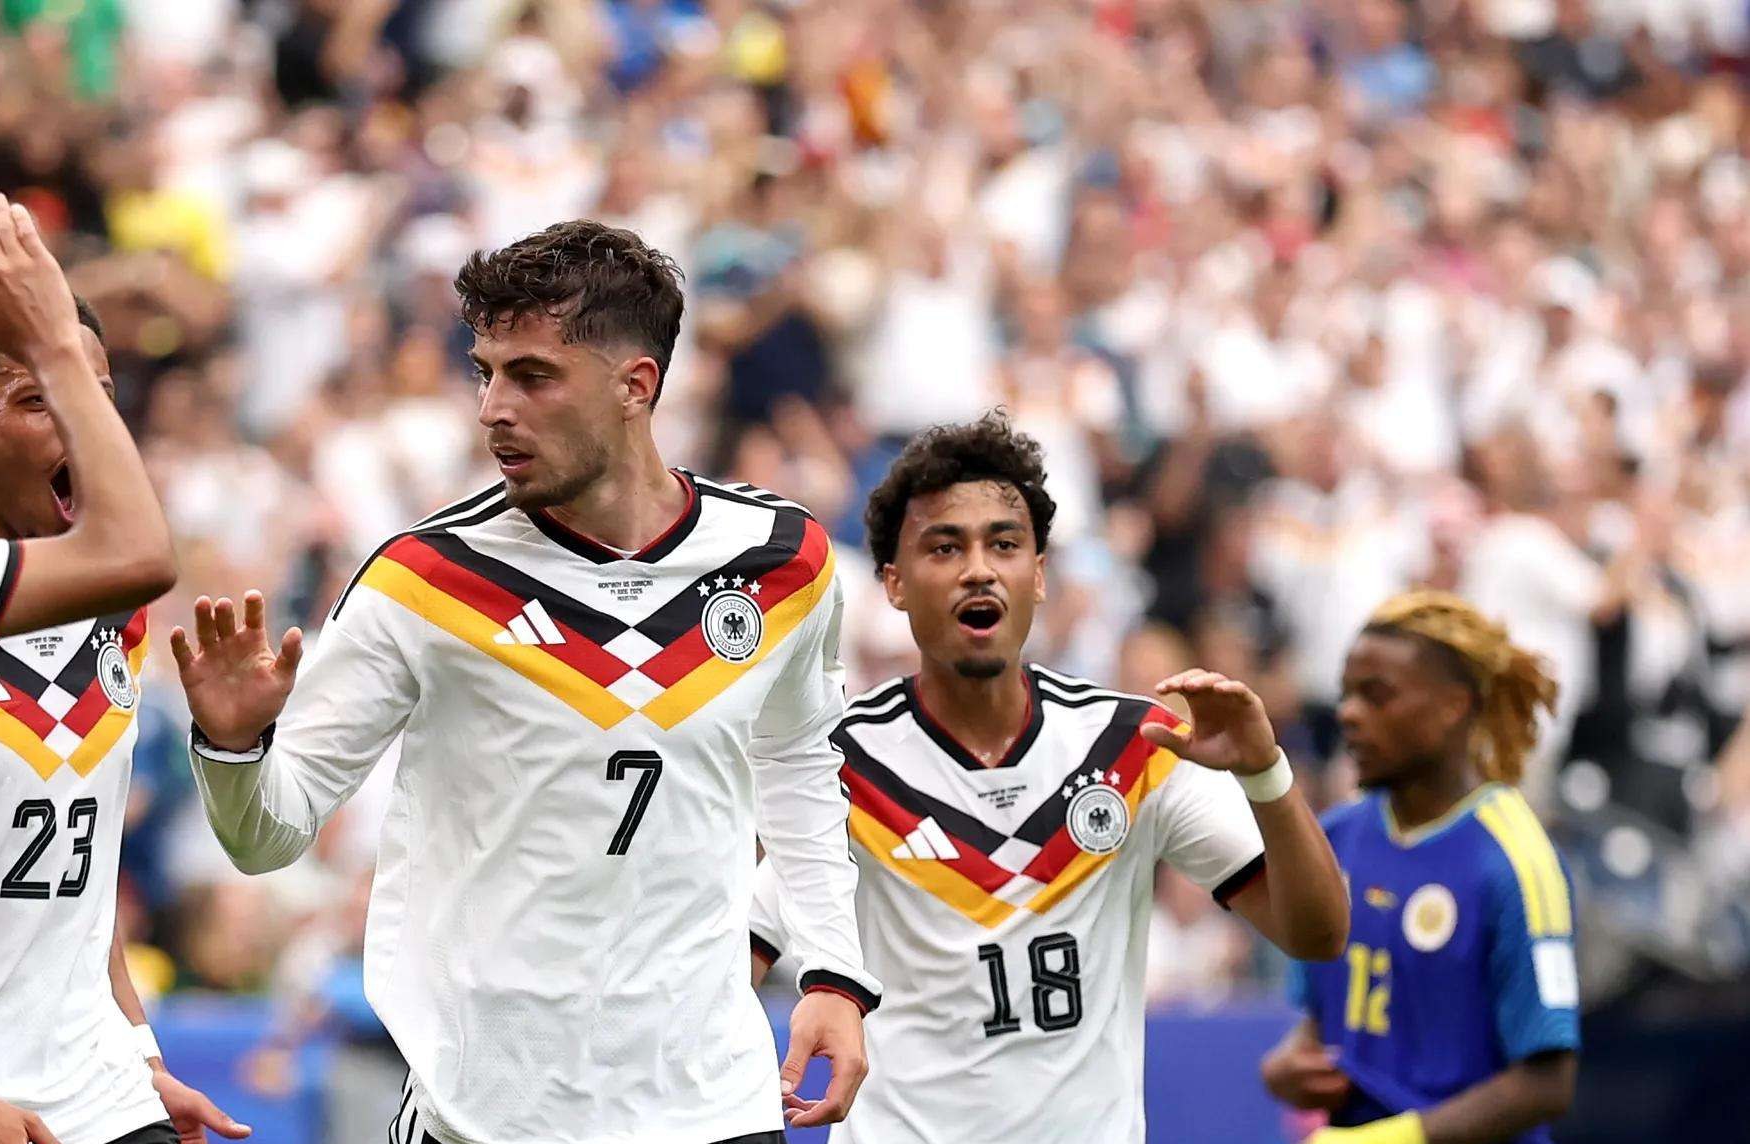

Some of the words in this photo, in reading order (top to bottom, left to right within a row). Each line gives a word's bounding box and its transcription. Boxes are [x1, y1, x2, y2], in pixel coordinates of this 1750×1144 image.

[0, 797, 98, 899] 23
[606, 750, 663, 855] 7
[978, 931, 1083, 1038] 18
[1346, 942, 1392, 1036] 12
